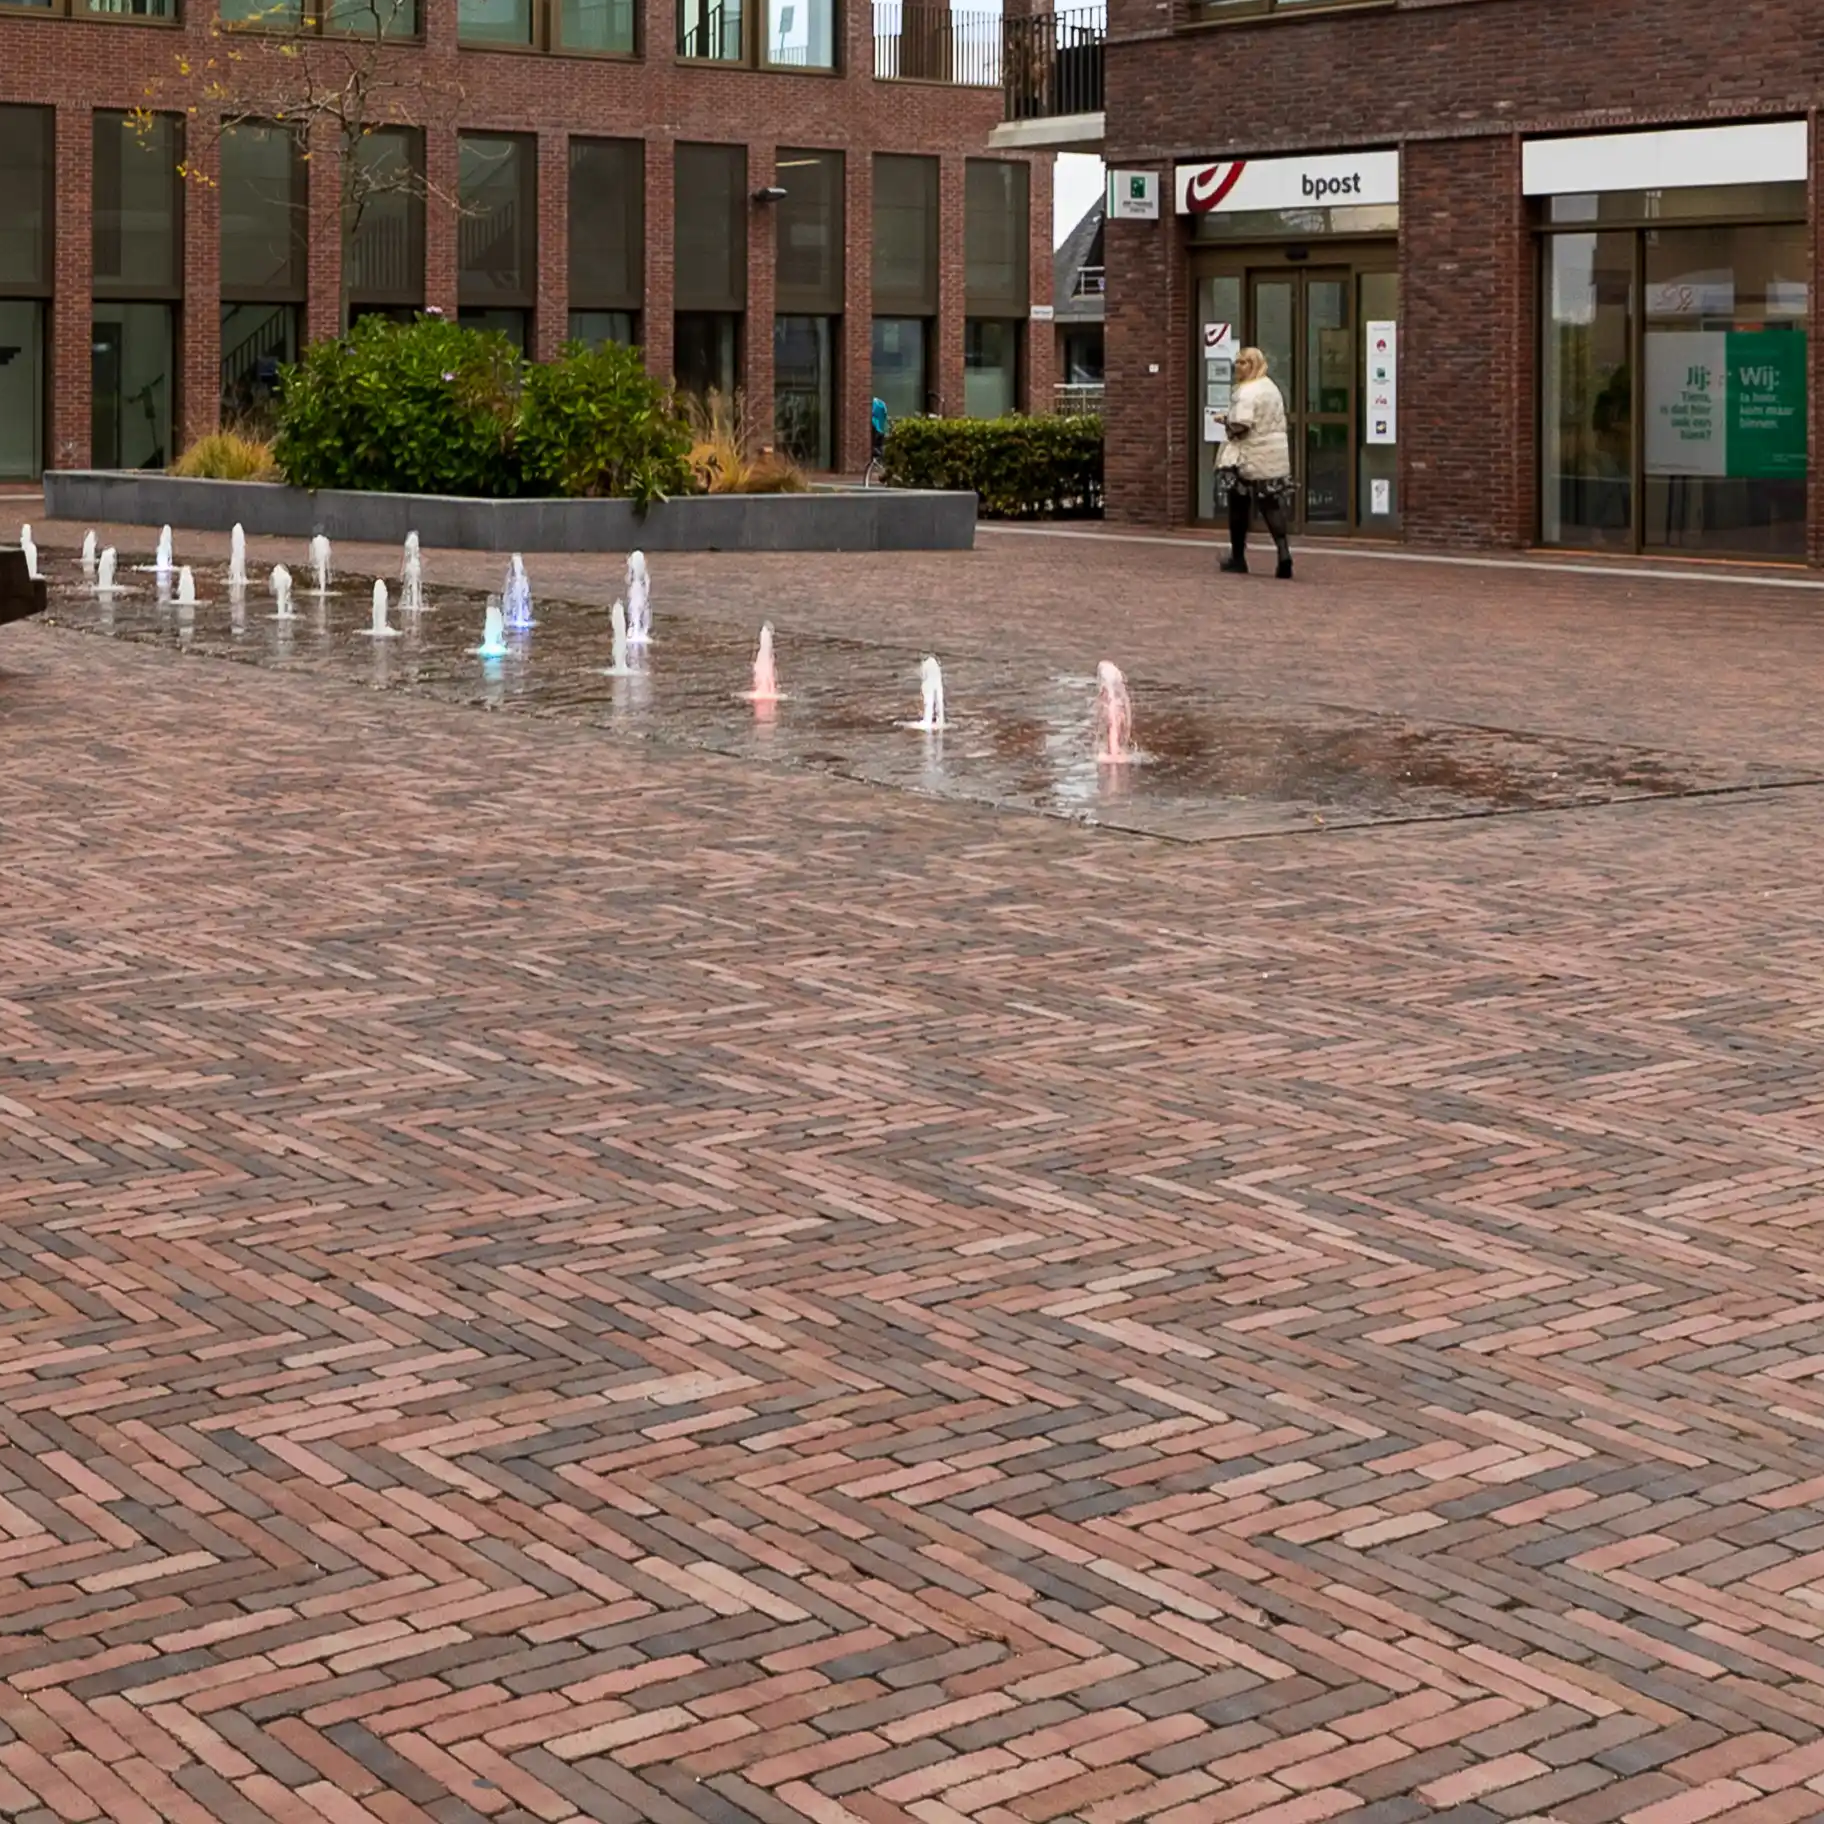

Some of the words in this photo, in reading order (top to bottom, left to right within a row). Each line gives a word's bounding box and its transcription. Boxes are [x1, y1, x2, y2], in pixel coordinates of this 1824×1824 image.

[1302, 172, 1361, 200] bpost
[1686, 366, 1711, 391] Jij:
[1739, 365, 1781, 392] Wij:
